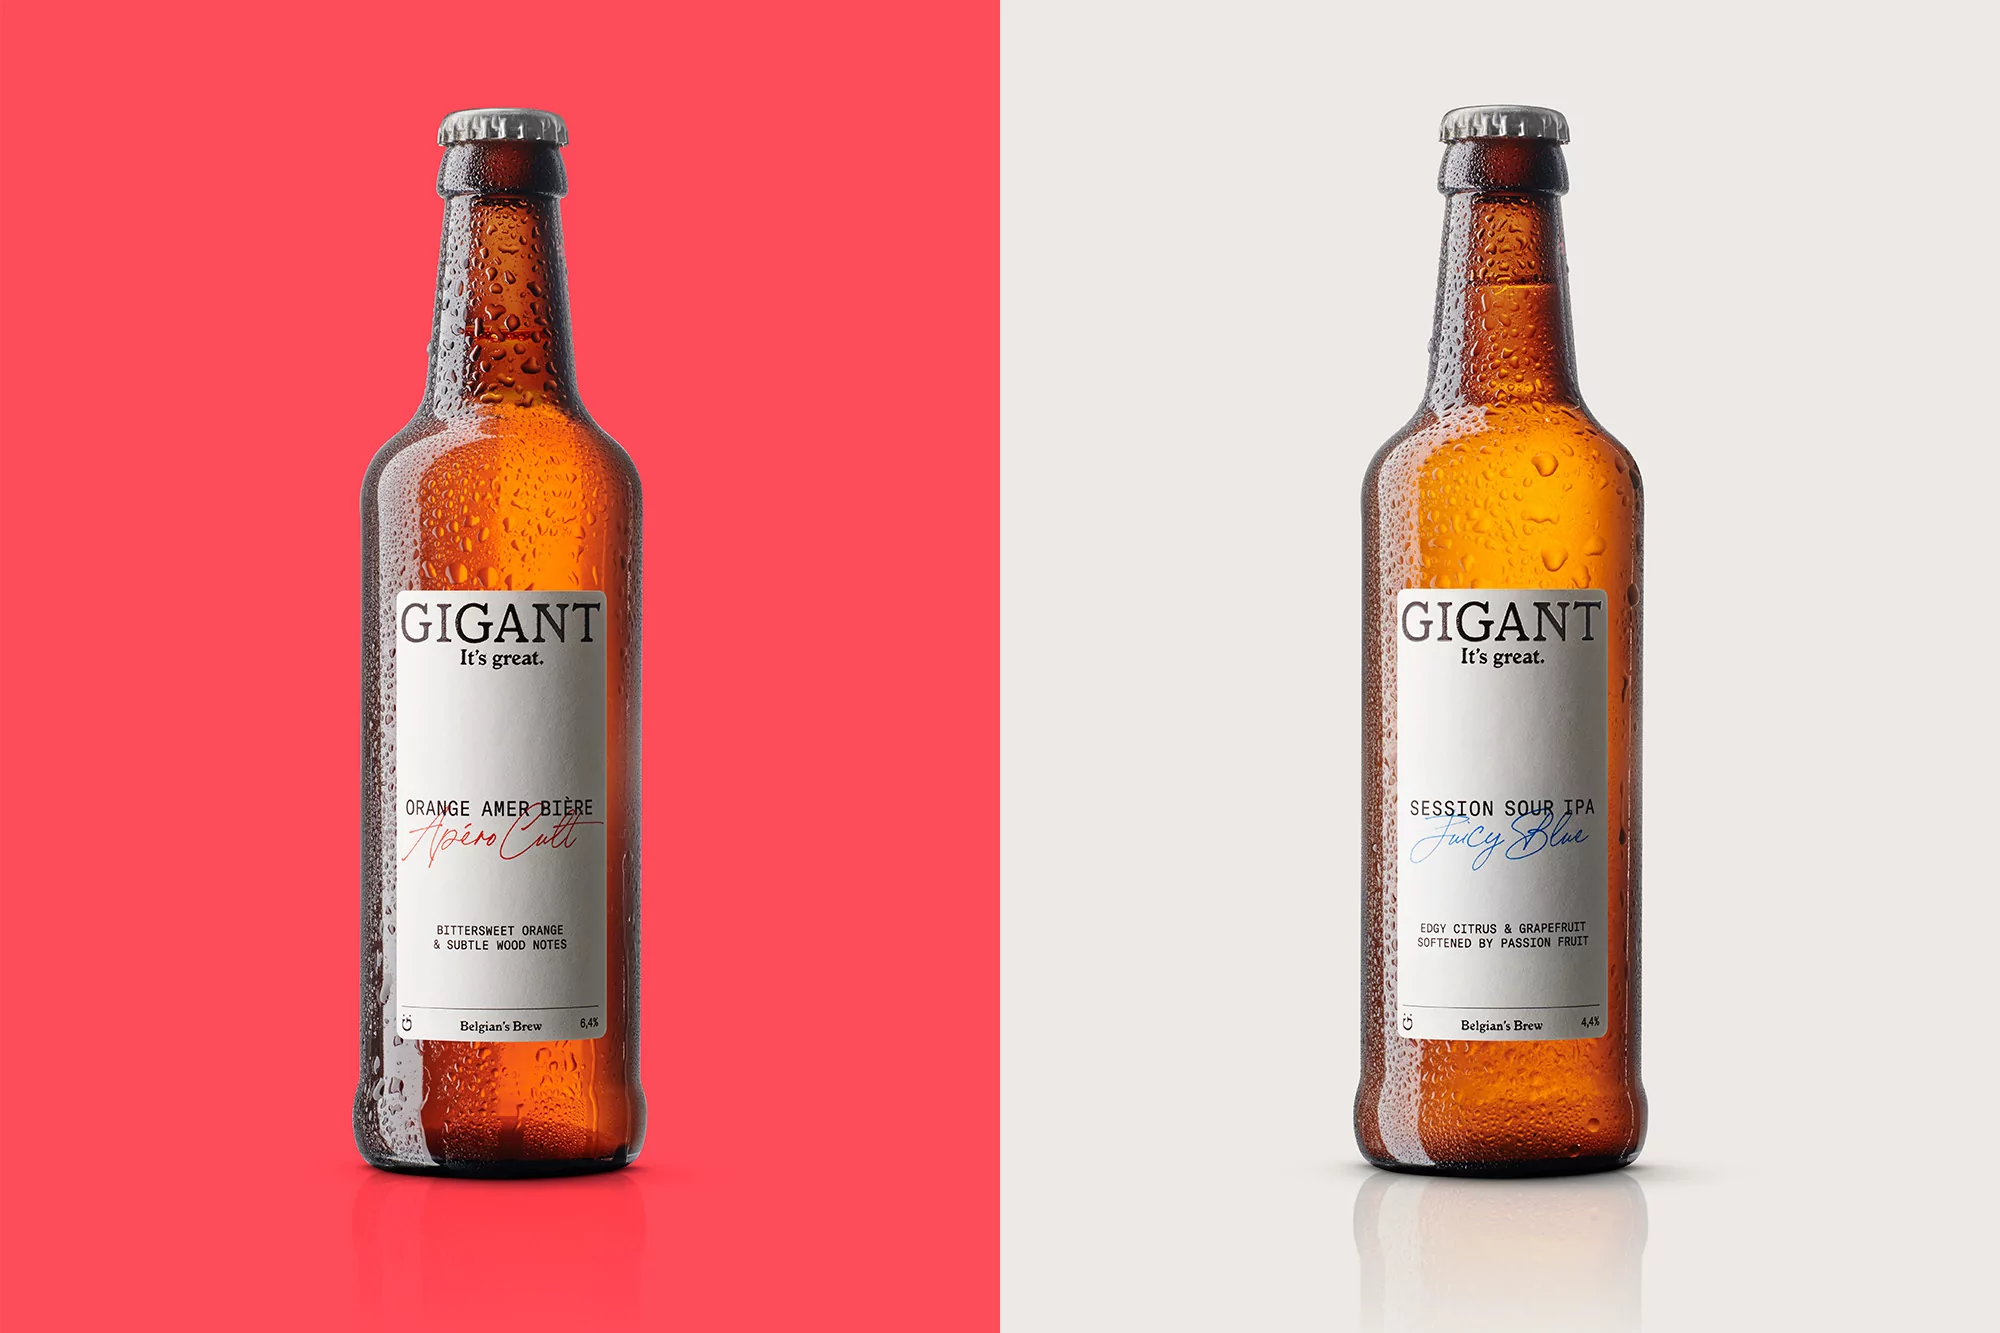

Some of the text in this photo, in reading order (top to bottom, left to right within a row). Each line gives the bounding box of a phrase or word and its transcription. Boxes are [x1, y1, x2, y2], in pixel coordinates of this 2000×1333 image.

[401, 603, 601, 643] GIGANT
[1401, 601, 1602, 642] GIGANT
[460, 649, 544, 669] It's great.
[1461, 648, 1545, 668] It's great.
[405, 797, 593, 816] ORANGE AMER BIÈRE
[1410, 799, 1595, 816] SESSION SOUR IPA
[401, 802, 604, 868] Apéro Cult
[1410, 808, 1589, 871] Juicy Blue
[437, 925, 564, 936] BITTERSWEET ORANGE
[1421, 921, 1586, 934] EDGY CITRUS & GRAPEFRUIT
[434, 939, 567, 950] & SUBTLE WOOD NOTES
[1417, 936, 1589, 949] SOFTENED BY PASSION FRUIT
[460, 1021, 542, 1034] Belgian's Brew
[580, 1017, 599, 1028] 6,4%
[1461, 1020, 1543, 1033] Belgian's Brew
[1581, 1016, 1600, 1028] 4,4%
